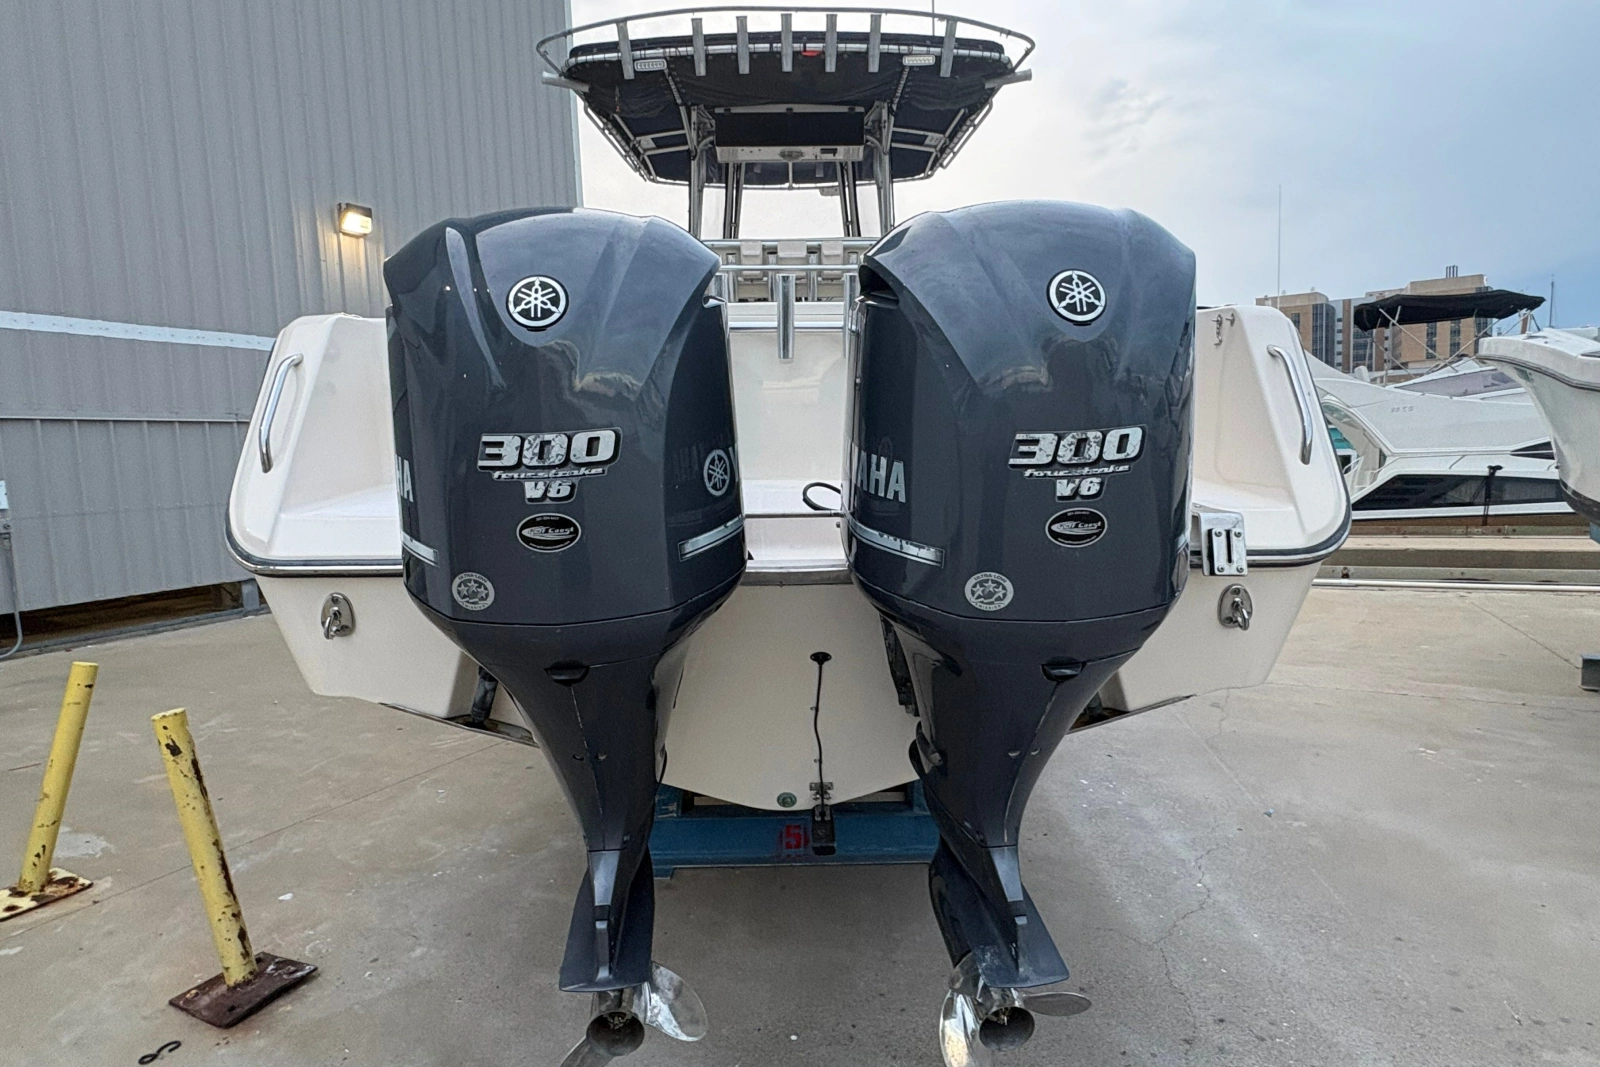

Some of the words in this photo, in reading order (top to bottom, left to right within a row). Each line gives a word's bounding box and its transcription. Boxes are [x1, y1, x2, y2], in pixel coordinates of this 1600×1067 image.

[478, 429, 618, 468] 300
[1008, 426, 1145, 466] 300
[524, 480, 574, 500] V6
[855, 448, 906, 503] AHA
[1056, 477, 1103, 498] V6
[785, 824, 802, 849] 5
